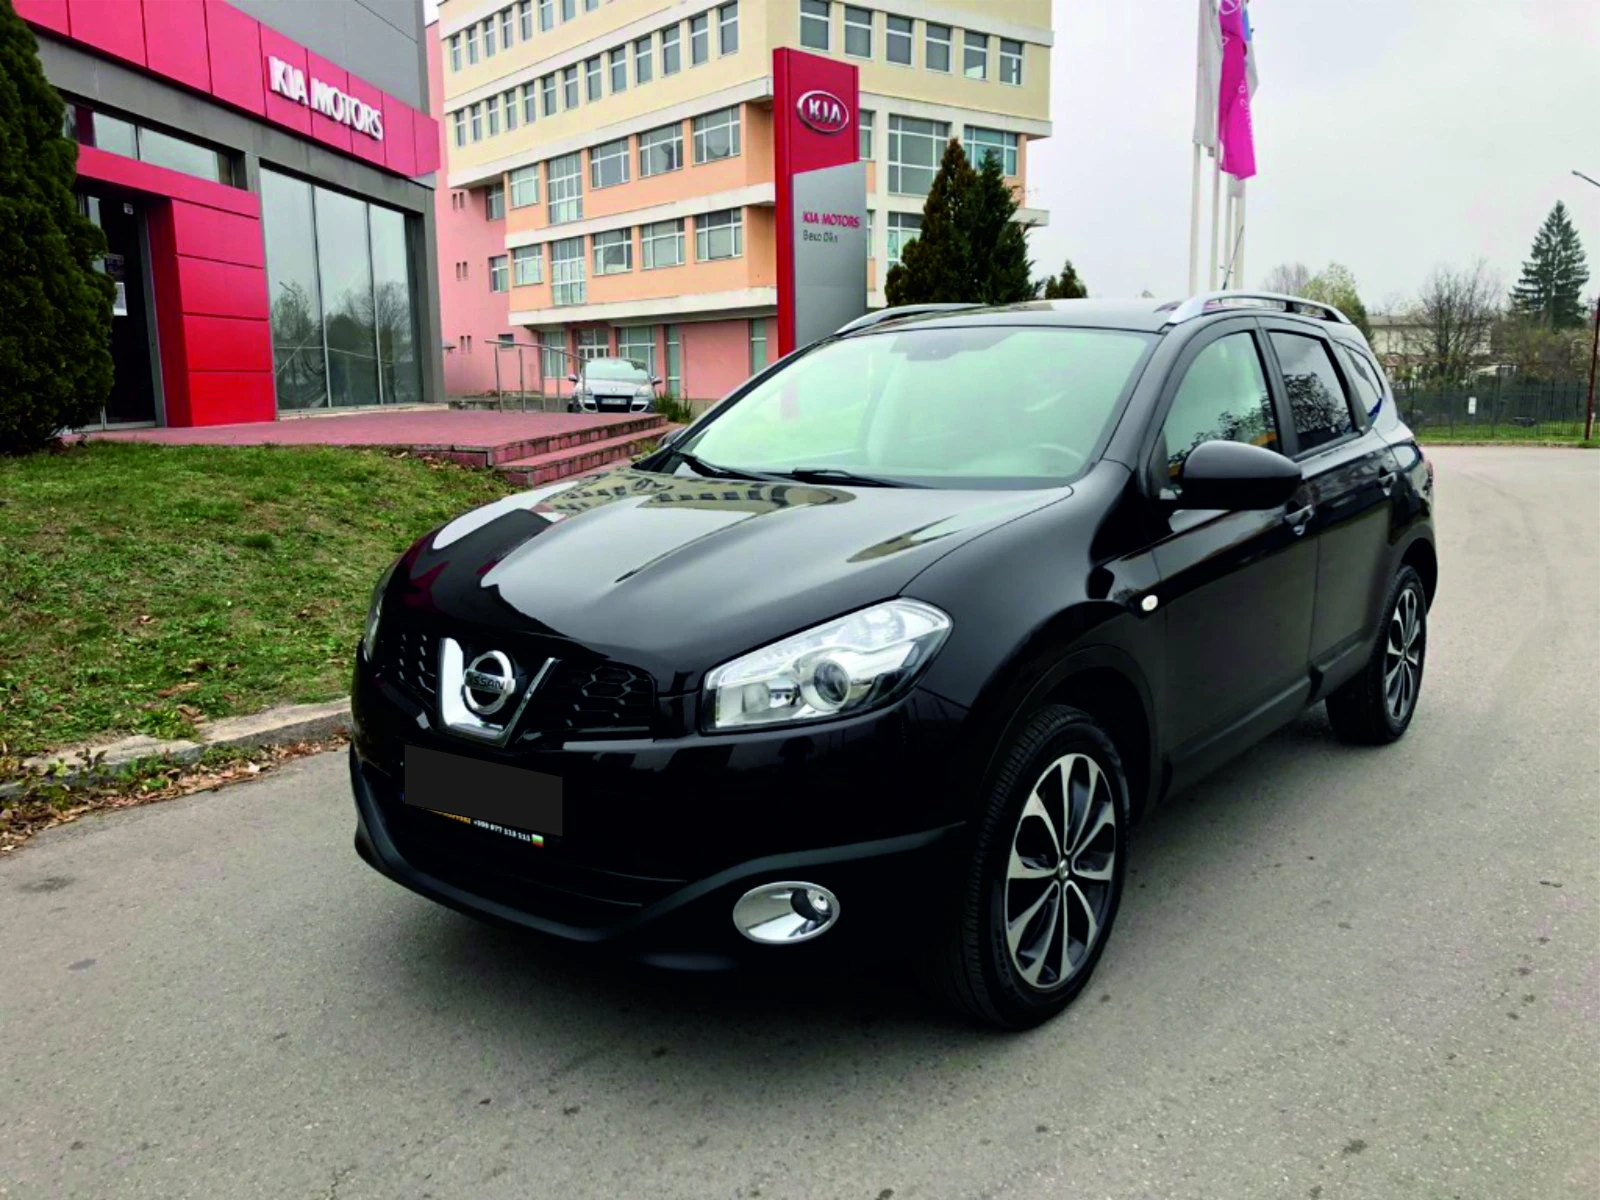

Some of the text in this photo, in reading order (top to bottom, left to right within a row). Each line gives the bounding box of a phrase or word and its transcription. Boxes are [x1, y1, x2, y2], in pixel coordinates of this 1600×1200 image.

[267, 55, 384, 141] KIA MOTORS
[808, 98, 842, 123] KIA
[802, 211, 860, 229] KIA MOTORS
